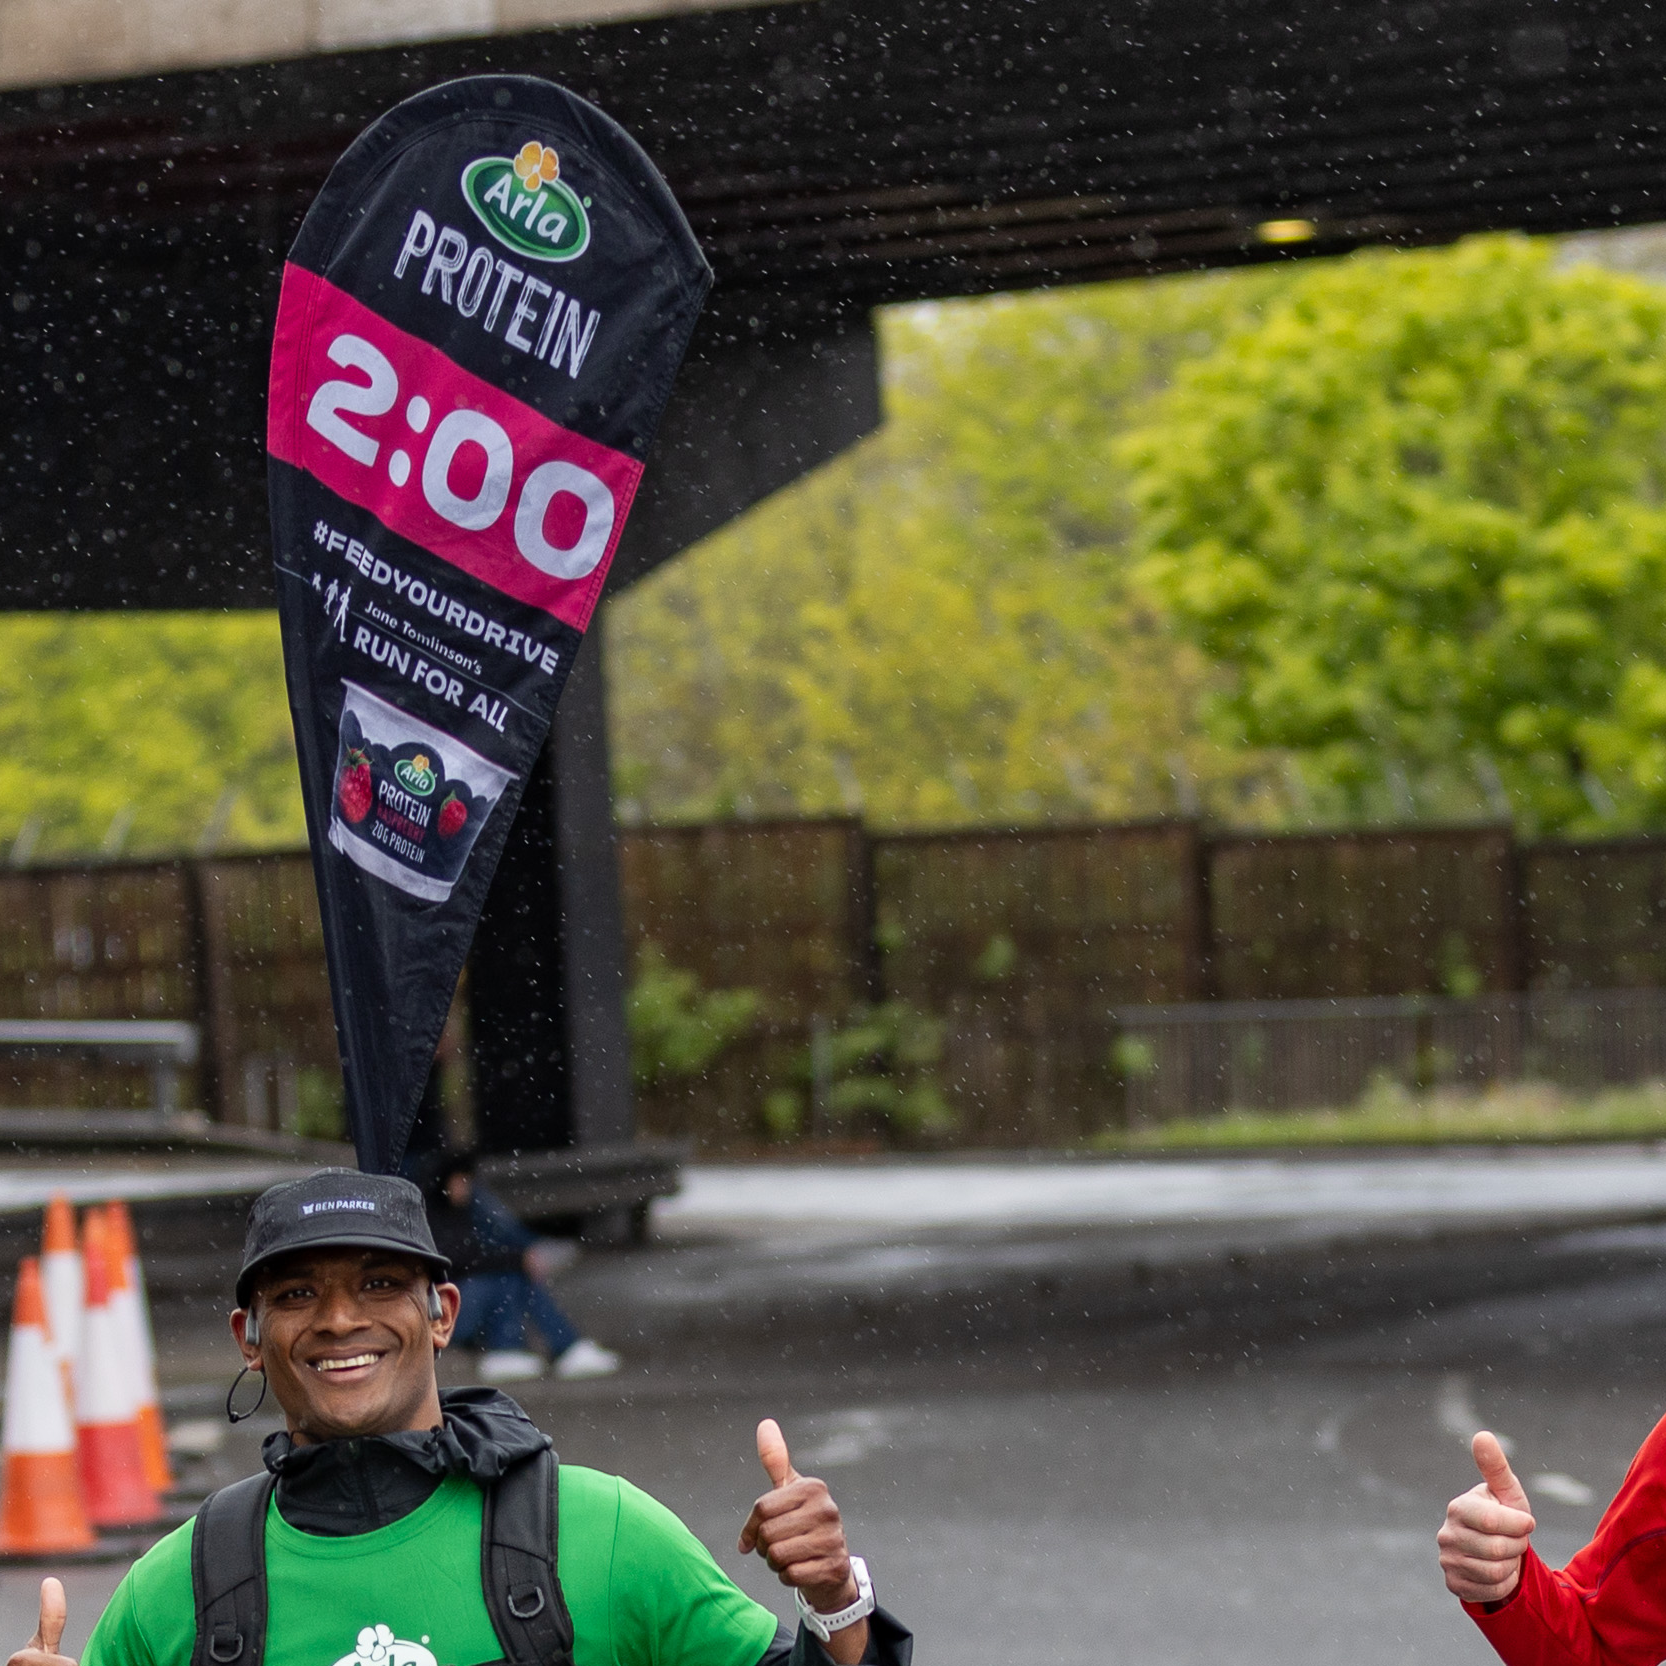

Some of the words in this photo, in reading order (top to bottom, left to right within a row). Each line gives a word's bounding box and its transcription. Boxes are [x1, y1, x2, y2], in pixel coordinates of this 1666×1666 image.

[483, 173, 568, 244] Arla
[393, 210, 601, 379] PROTEIN
[306, 334, 615, 580] 2:00
[313, 520, 560, 676] #FEEDYOURDRIVE
[364, 601, 398, 629] Jane
[402, 621, 483, 676] Tomlinson's
[353, 625, 411, 676] RUN
[412, 659, 464, 707] FOR
[467, 693, 509, 733] ALL
[378, 780, 432, 828] PROTEIN
[400, 765, 430, 790] Arla
[371, 820, 390, 844] 20G
[389, 832, 426, 864] PROTEIN
